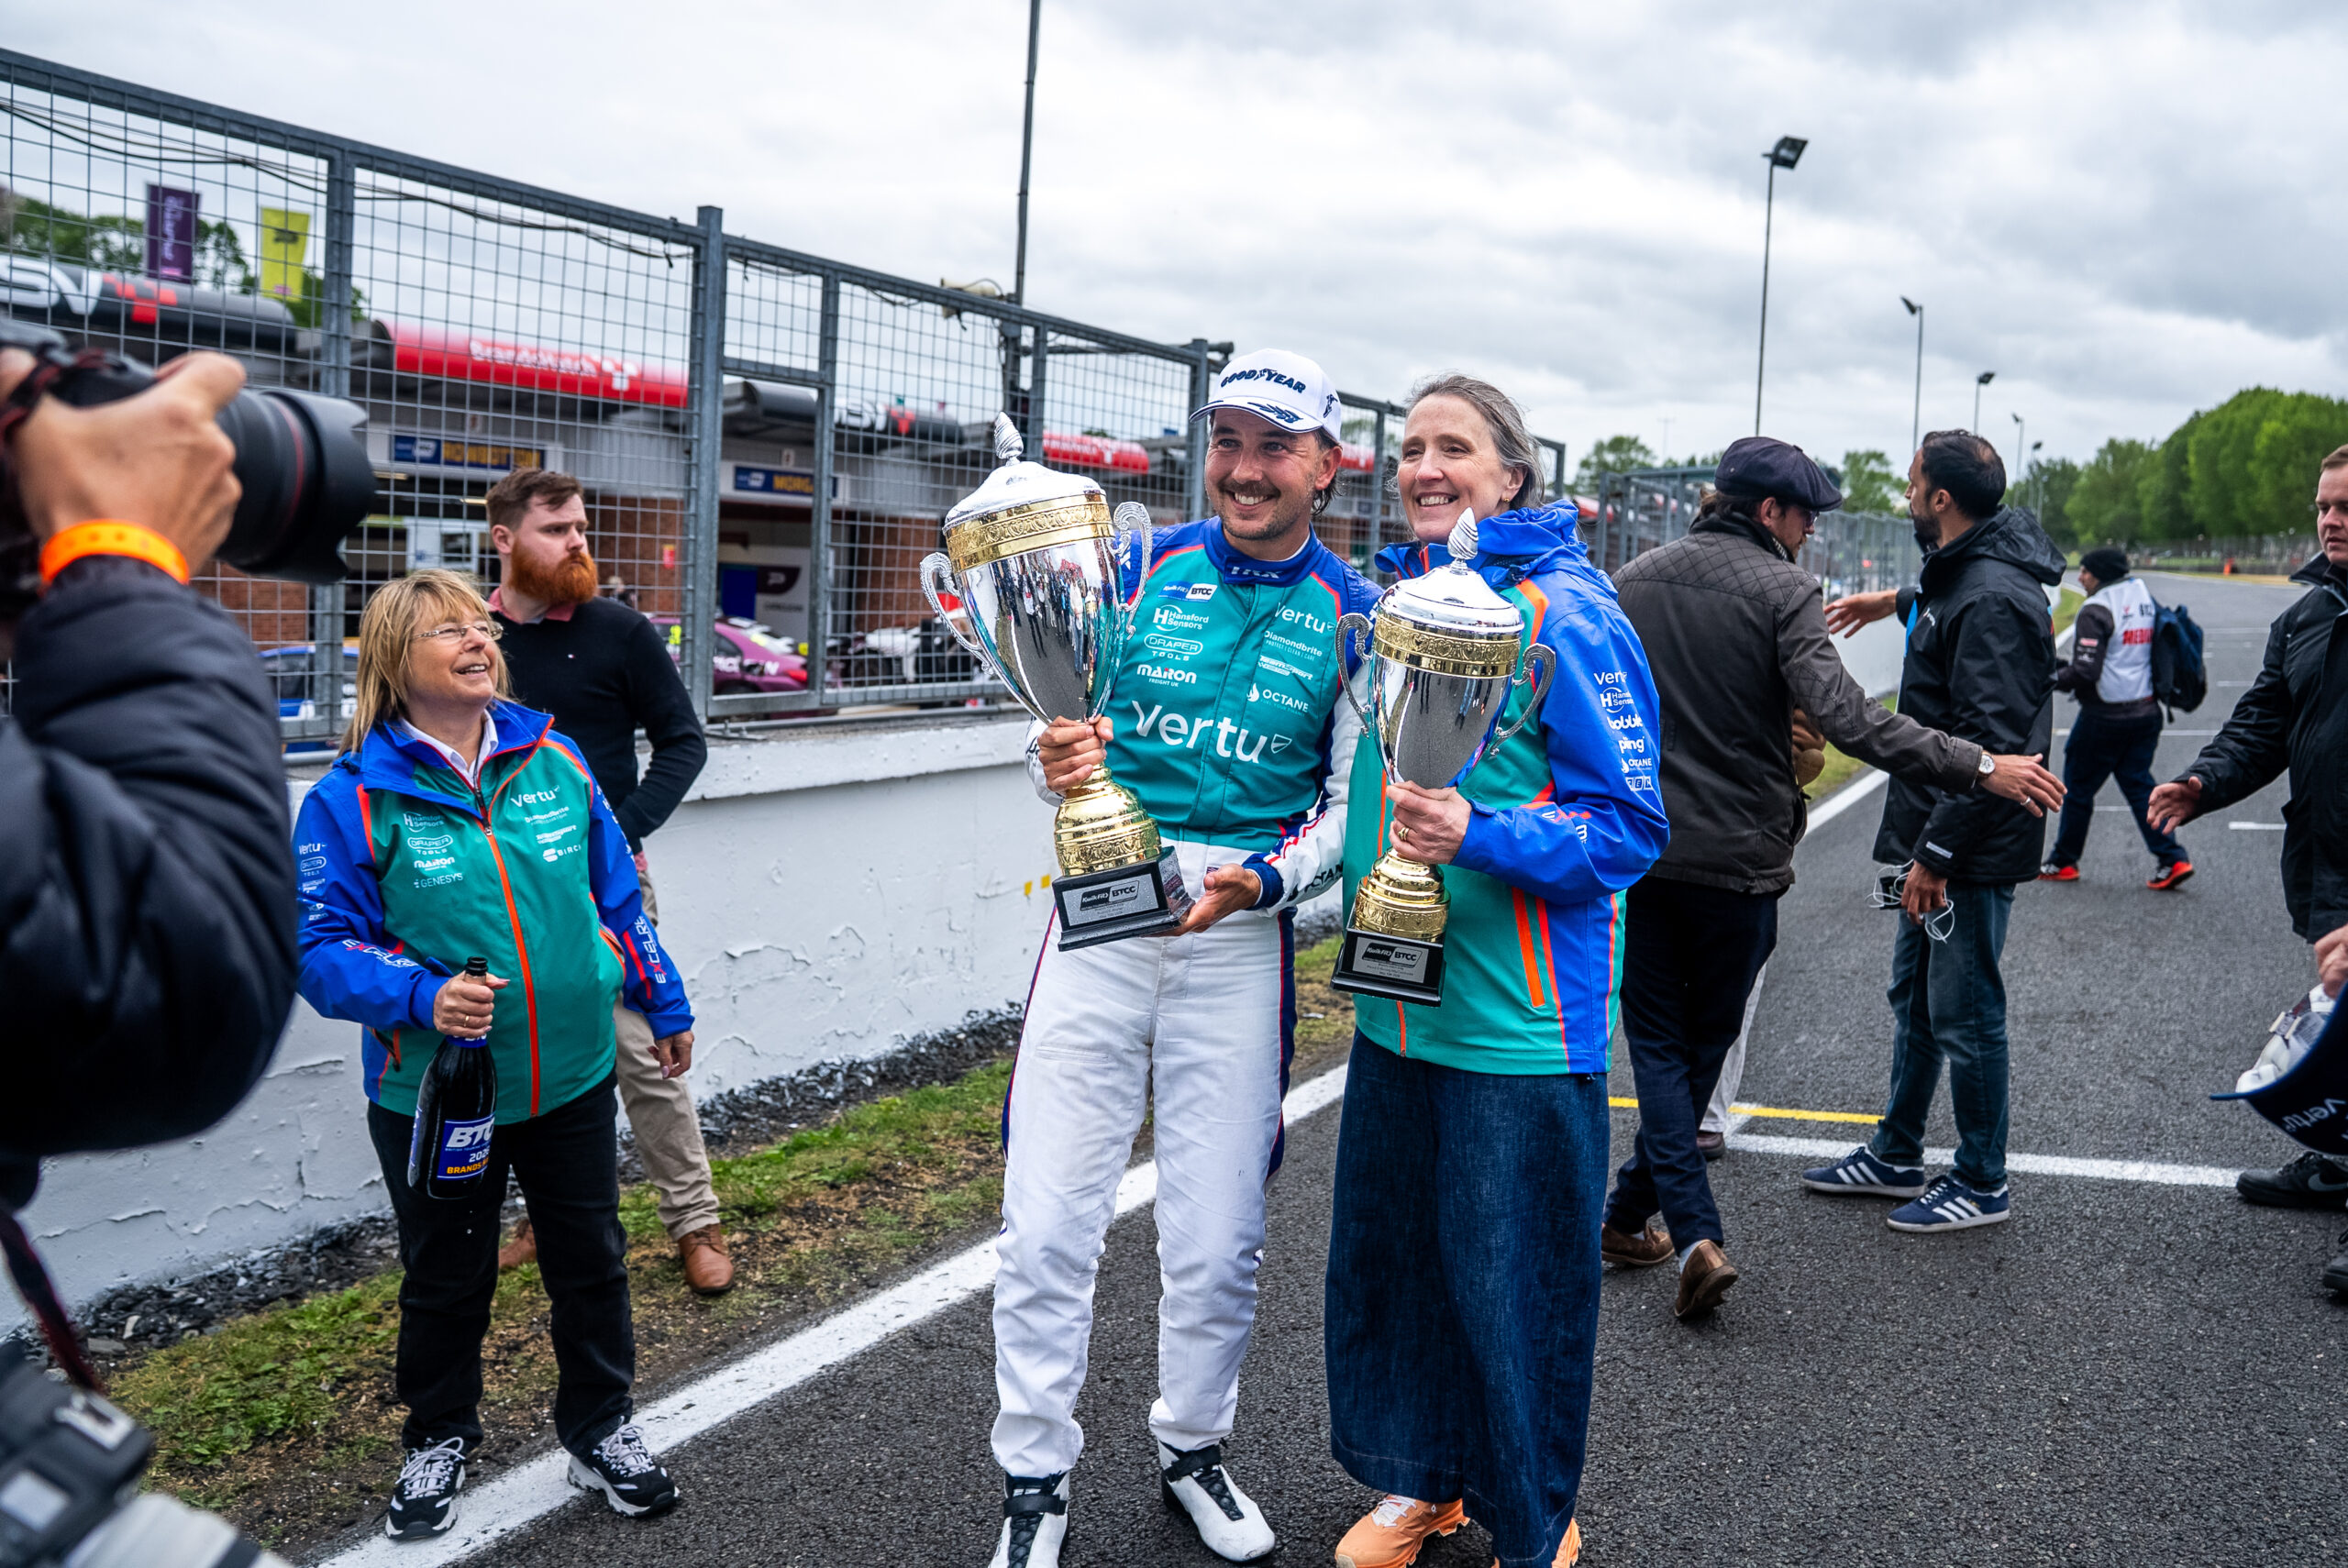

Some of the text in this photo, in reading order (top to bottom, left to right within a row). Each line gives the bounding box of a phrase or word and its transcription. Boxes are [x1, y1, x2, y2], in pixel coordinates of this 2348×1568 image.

[1220, 368, 1306, 393] GOODYEAR
[1191, 587, 1213, 596] BTCC
[1169, 609, 1210, 624] Hansford
[1275, 602, 1326, 634] Vertu
[1167, 618, 1203, 631] Sensors
[1148, 635, 1199, 652] DRAPER
[1264, 630, 1323, 657] Diamondbrite
[1152, 650, 1191, 661] TOOLS
[1148, 678, 1169, 686] FREIGHT
[1262, 689, 1309, 712] OCTANE
[1131, 700, 1268, 764] Vertu
[510, 790, 557, 808] Vertu
[420, 872, 463, 888] GENESYS
[1112, 885, 1136, 898] BTCC
[1394, 951, 1417, 962] BTCC
[446, 1163, 482, 1175] BRANDS
